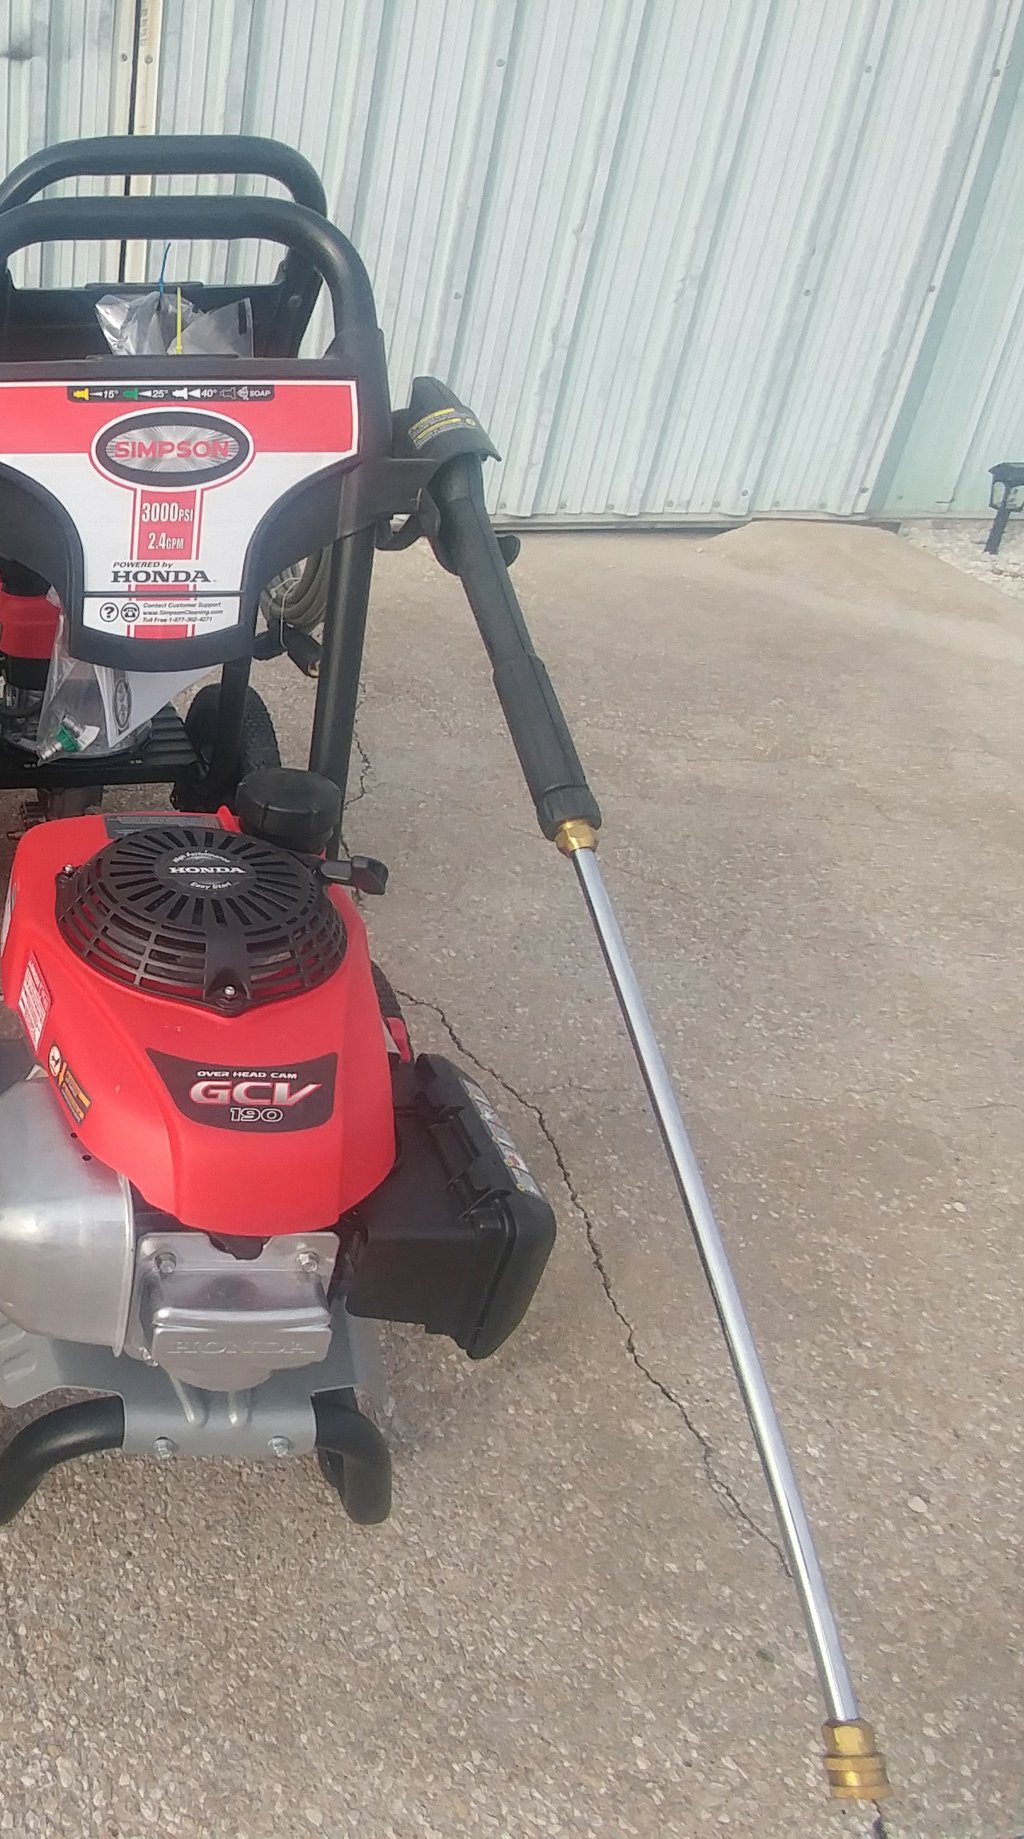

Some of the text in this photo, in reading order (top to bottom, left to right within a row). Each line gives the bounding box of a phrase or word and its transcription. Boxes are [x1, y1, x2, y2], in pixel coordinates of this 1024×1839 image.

[249, 389, 271, 397] SOAP
[114, 439, 231, 459] SIMPSON
[141, 502, 193, 522] 3000PSI
[148, 532, 184, 550] 2.4GPM
[161, 561, 173, 569] by
[111, 570, 211, 583] HONDA
[168, 866, 247, 874] HONDA
[197, 1070, 297, 1080] OVER HEAD CAM
[189, 1080, 322, 1106] GCV
[229, 1107, 283, 1123] 190
